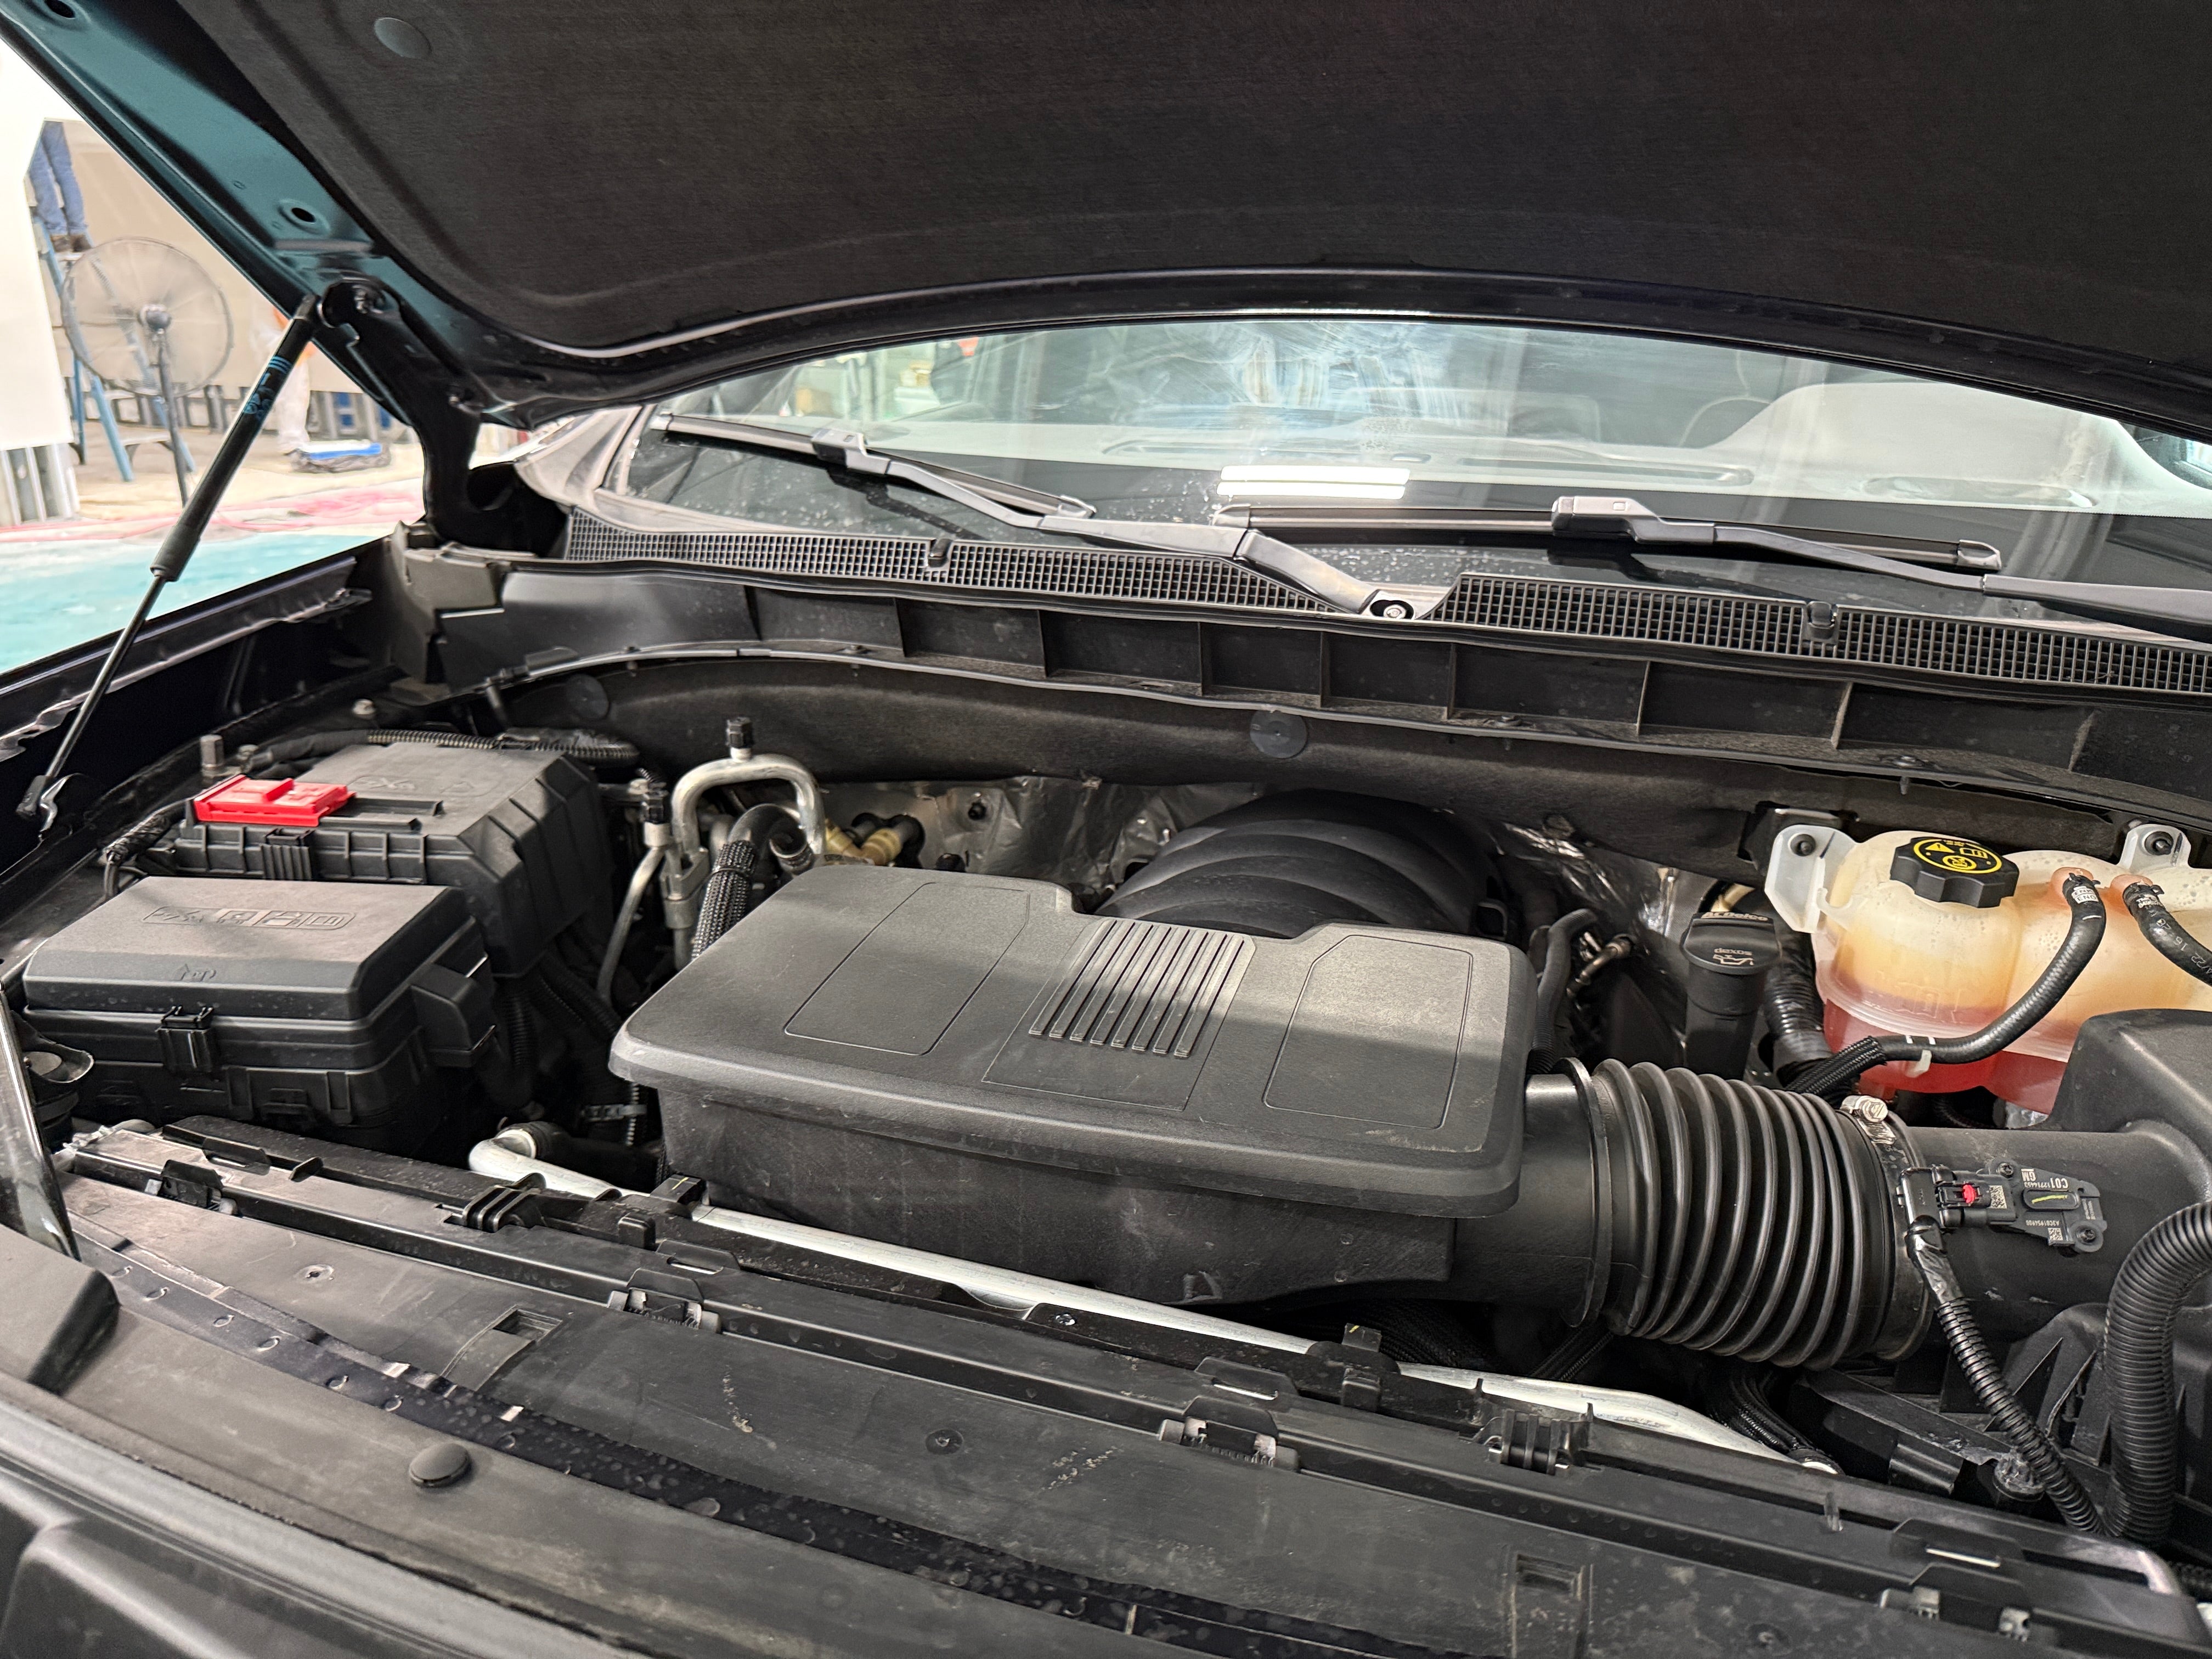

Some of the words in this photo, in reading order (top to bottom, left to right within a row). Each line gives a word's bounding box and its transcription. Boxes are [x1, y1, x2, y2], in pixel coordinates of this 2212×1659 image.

[1701, 912, 1768, 921] ACDelco
[1714, 947, 1753, 956] dexos
[2022, 1171, 2036, 1182] GM
[2050, 1177, 2069, 1189] C01
